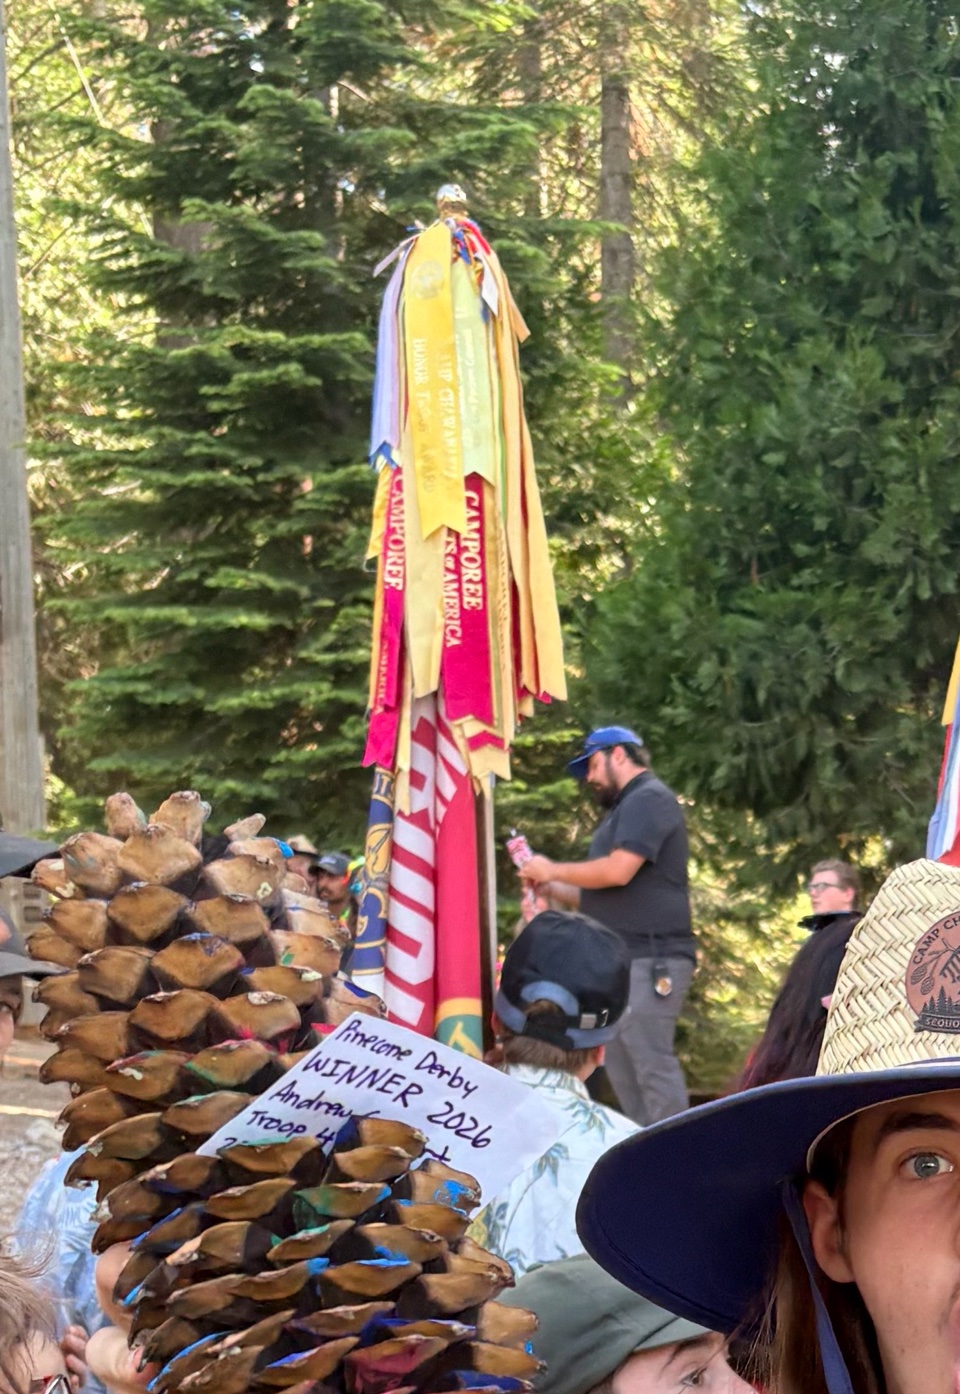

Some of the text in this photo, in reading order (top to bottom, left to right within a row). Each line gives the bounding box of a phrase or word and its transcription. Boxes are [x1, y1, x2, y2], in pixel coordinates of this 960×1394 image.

[412, 338, 429, 385] HONOR
[443, 570, 462, 648] AMERICA
[912, 928, 941, 965] CAMP
[335, 1019, 414, 1061] Pinecone
[415, 1051, 479, 1100] Derby
[271, 1079, 351, 1119] Andrew
[302, 1051, 423, 1108] WINNER
[427, 1101, 491, 1149] 2026
[246, 1109, 307, 1138] Troop
